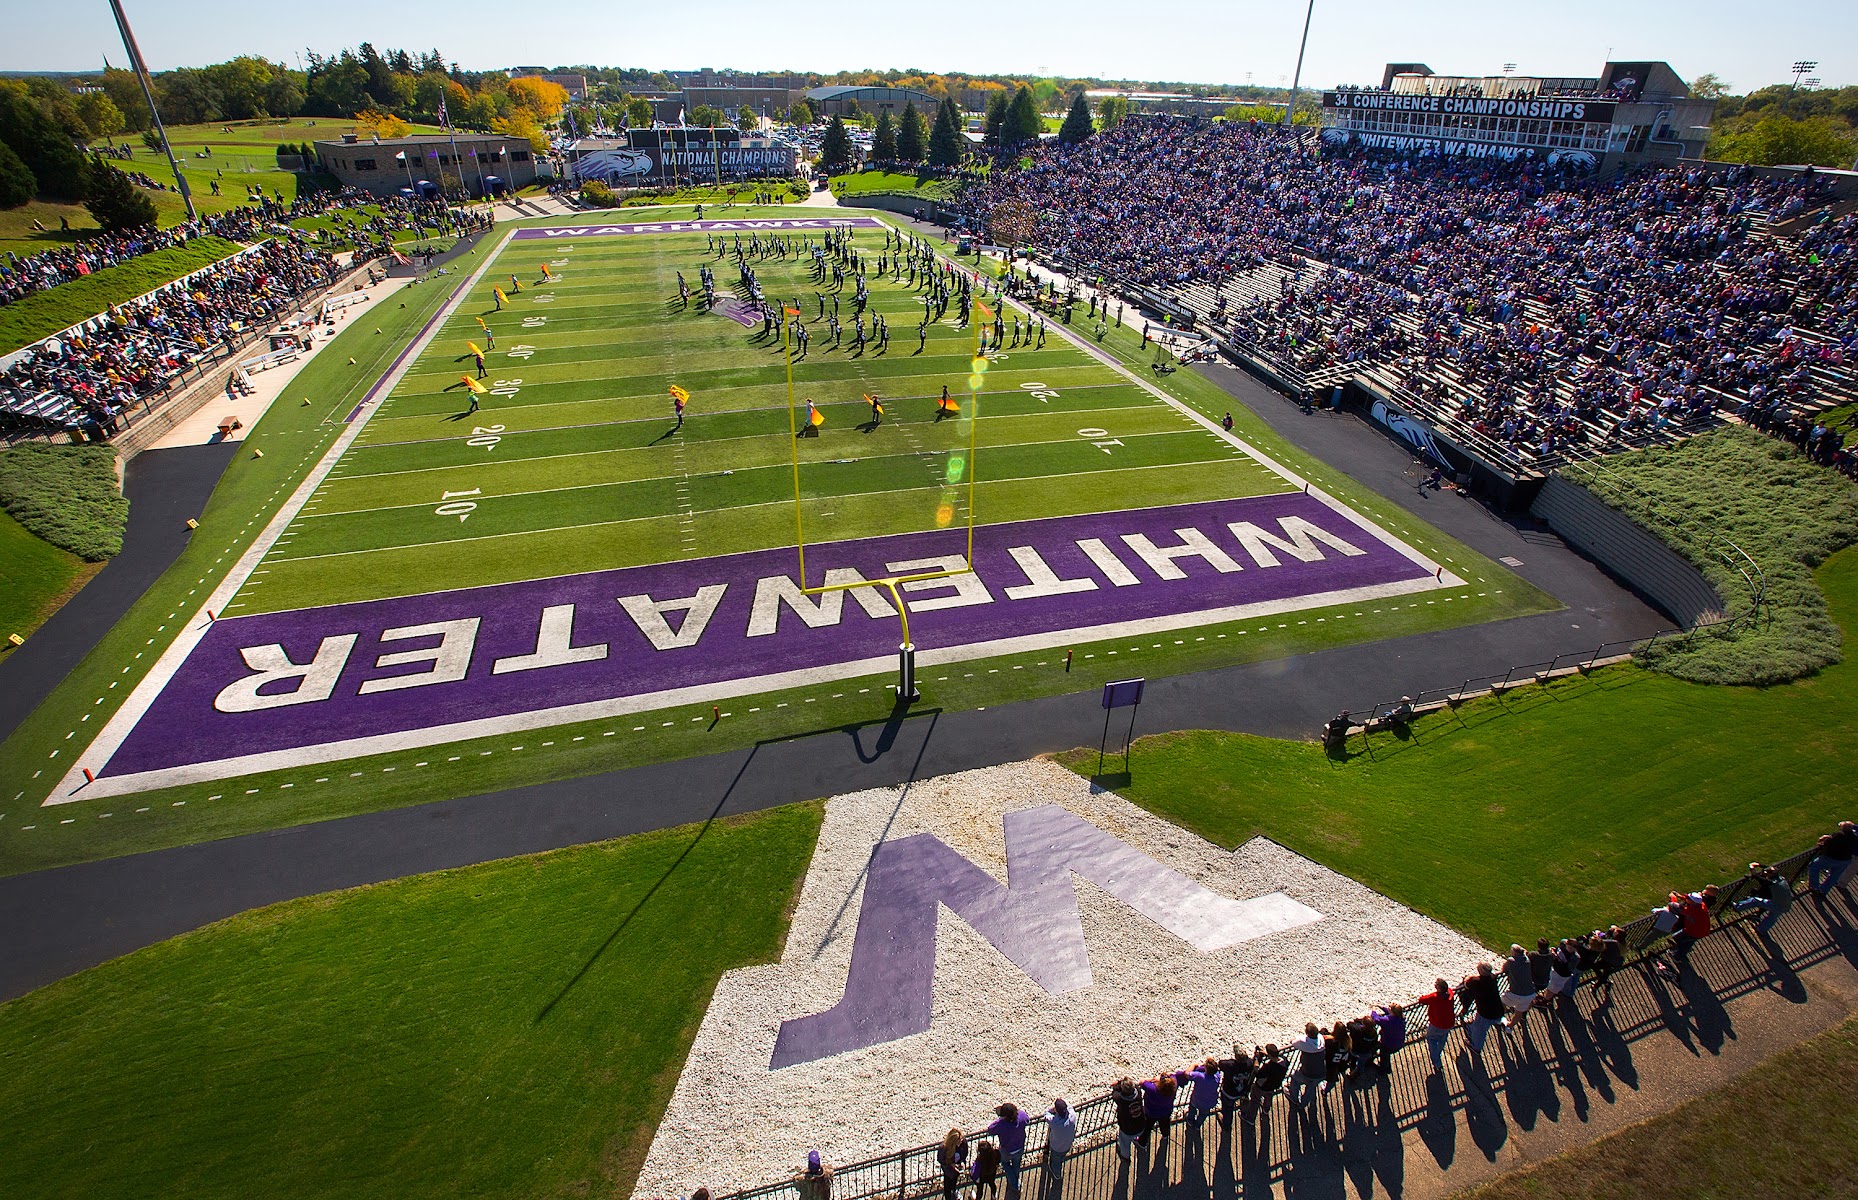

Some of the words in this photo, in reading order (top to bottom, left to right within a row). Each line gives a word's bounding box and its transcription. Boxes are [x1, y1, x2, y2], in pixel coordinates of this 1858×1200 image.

[1335, 94, 1348, 107] 34
[1353, 95, 1438, 112] CONFERENCE
[1443, 97, 1586, 120] CHAMPIONSHIPS
[1359, 133, 1441, 154] WHITEWATER
[1444, 140, 1536, 161] WARHAWKS
[662, 151, 716, 166] NATIONAL
[721, 150, 787, 165] CHAMPIONS
[543, 220, 856, 237] WARHAWKS
[507, 344, 537, 359] 40
[489, 378, 523, 396] 30
[1020, 382, 1061, 399] 20
[466, 424, 506, 447] 20
[1077, 428, 1125, 449] 10
[434, 487, 482, 517] 10
[213, 515, 1369, 714] WHITEWATER
